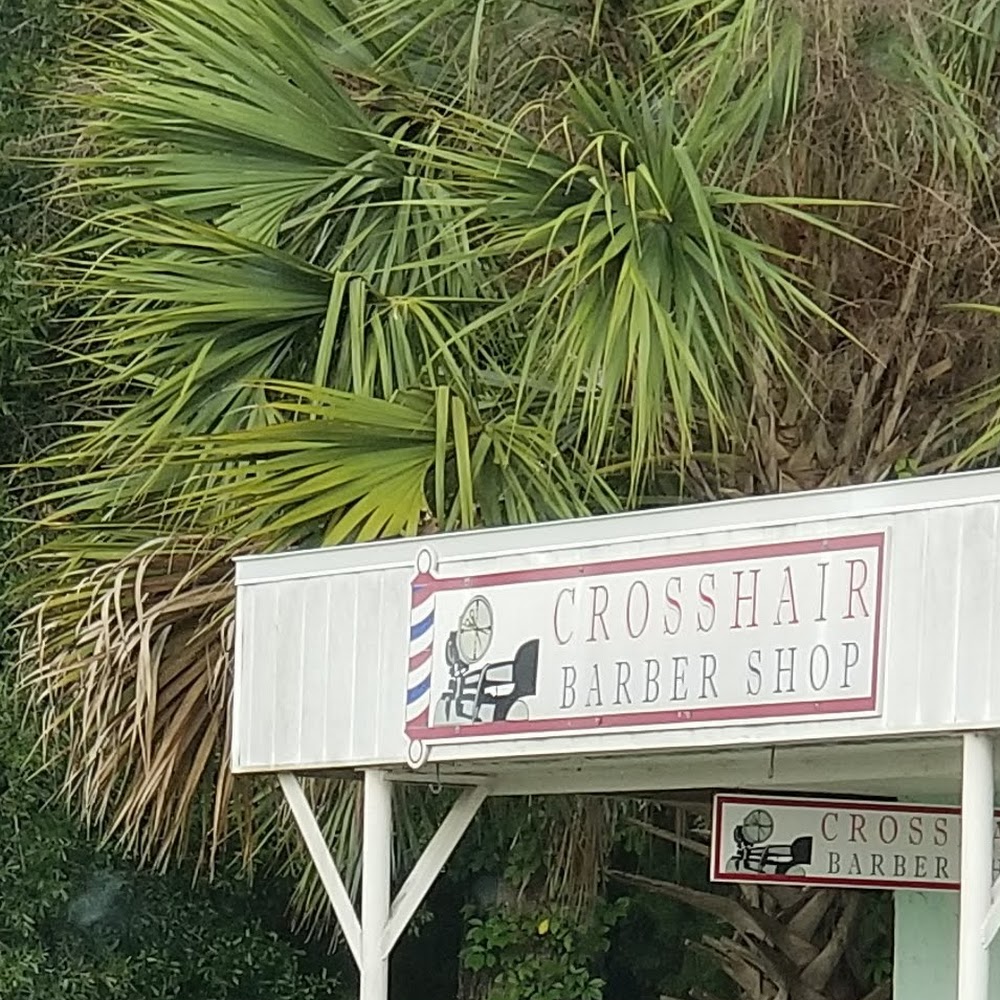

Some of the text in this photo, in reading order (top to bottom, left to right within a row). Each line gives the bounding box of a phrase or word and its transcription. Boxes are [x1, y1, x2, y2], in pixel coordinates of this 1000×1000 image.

[553, 558, 870, 646] CROSSHAIR
[559, 641, 860, 710] BARBER SHOP
[827, 851, 949, 879] BARBER
